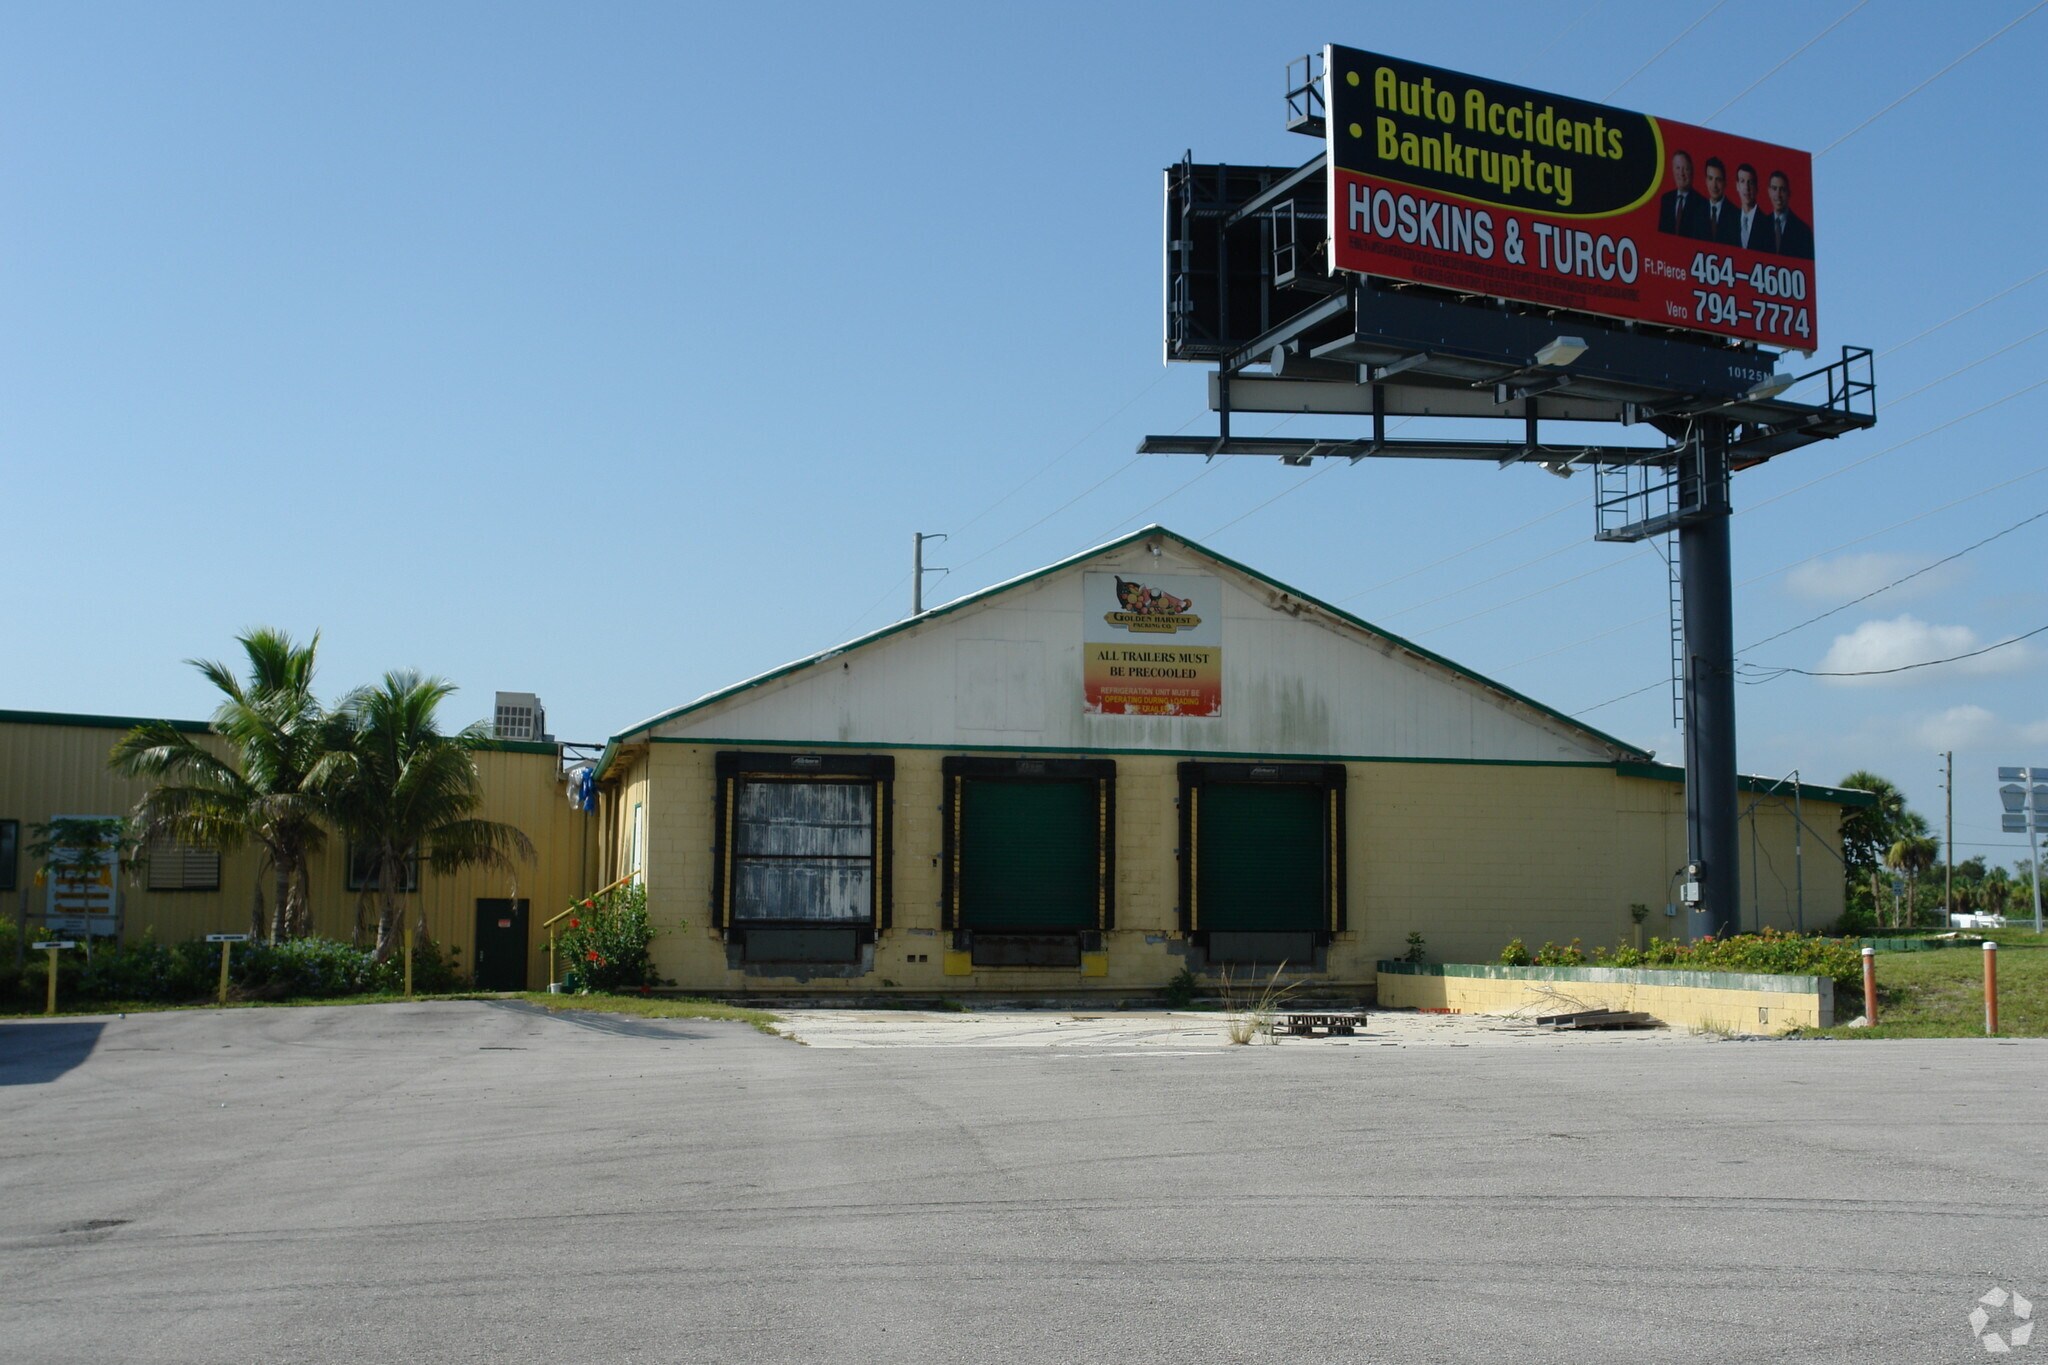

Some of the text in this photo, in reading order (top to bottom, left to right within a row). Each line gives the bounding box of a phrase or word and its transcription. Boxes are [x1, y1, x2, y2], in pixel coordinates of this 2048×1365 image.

[1375, 66, 1624, 160] Auto Accidents
[1376, 116, 1573, 207] Bankruptcy
[1349, 183, 1495, 259] HOSKINS
[1505, 218, 1526, 265] &
[1533, 222, 1639, 284] TURCO
[1644, 258, 1687, 281] Ft.Pierce
[1691, 252, 1806, 300] 464-4600
[1666, 290, 1810, 339] Vero 794-7774
[1113, 611, 1192, 624] GOLDEN HARVEST
[1098, 651, 1210, 664] ALL TRAILERS MUST
[1110, 666, 1197, 679] BE PRECOOLED
[1100, 687, 1200, 697] REFRIGERATION UNIT MUST BE
[1104, 696, 1200, 706] OPERATING DURING LOADING
